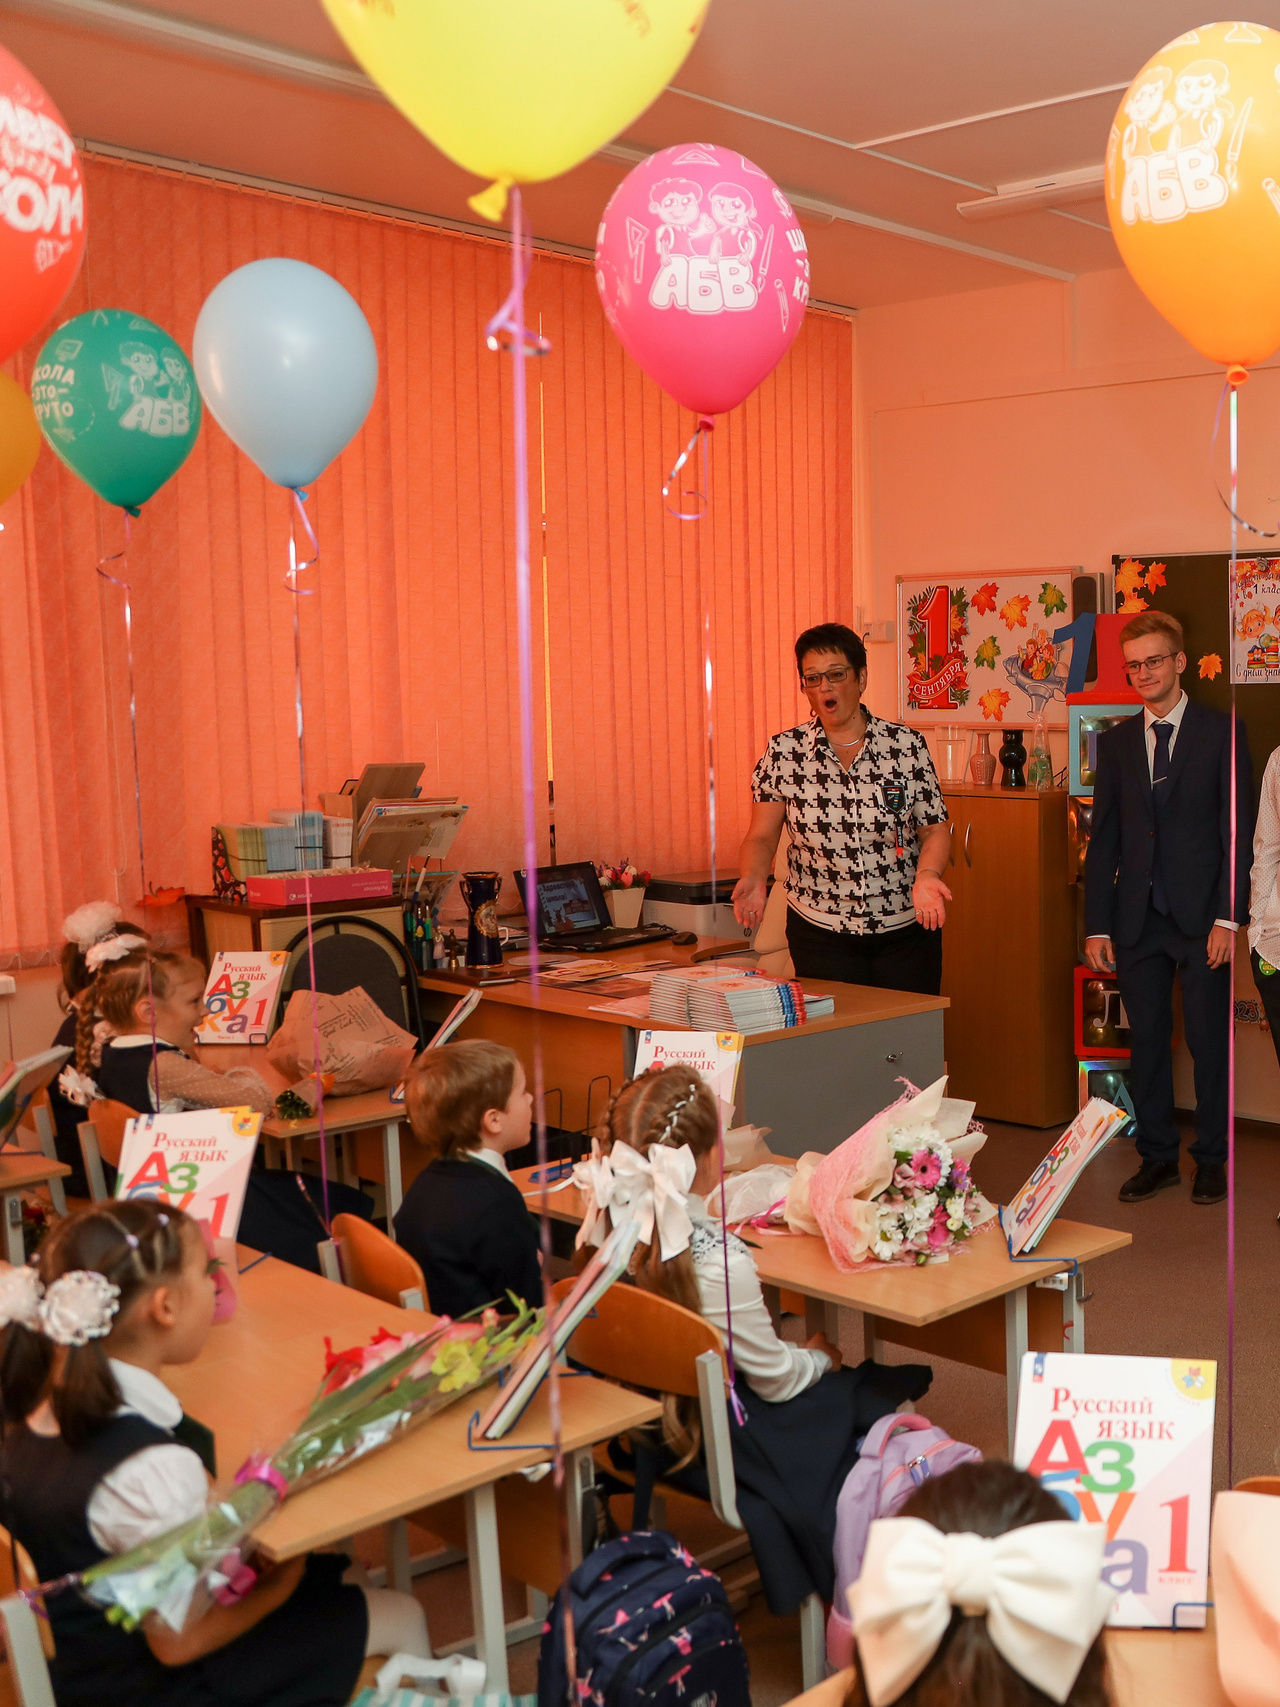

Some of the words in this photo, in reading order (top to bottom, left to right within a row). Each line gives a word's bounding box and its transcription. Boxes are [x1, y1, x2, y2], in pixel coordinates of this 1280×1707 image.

[1121, 149, 1229, 225] АБВ
[649, 253, 758, 315] АБВ
[34, 364, 75, 385] КОЛА
[119, 396, 190, 437] АБВ
[1253, 583, 1258, 595] 1
[916, 585, 960, 711] 1
[913, 661, 962, 697] СЕНТЯБРЯ
[223, 962, 261, 973] Русский
[250, 998, 268, 1026] 1
[653, 1045, 706, 1060] Русский
[153, 1132, 217, 1150] Русский
[209, 1193, 230, 1239] 1
[1052, 1387, 1153, 1418] Русский
[1097, 1421, 1174, 1440] ЯЗЫК
[1158, 1495, 1197, 1573] 1
